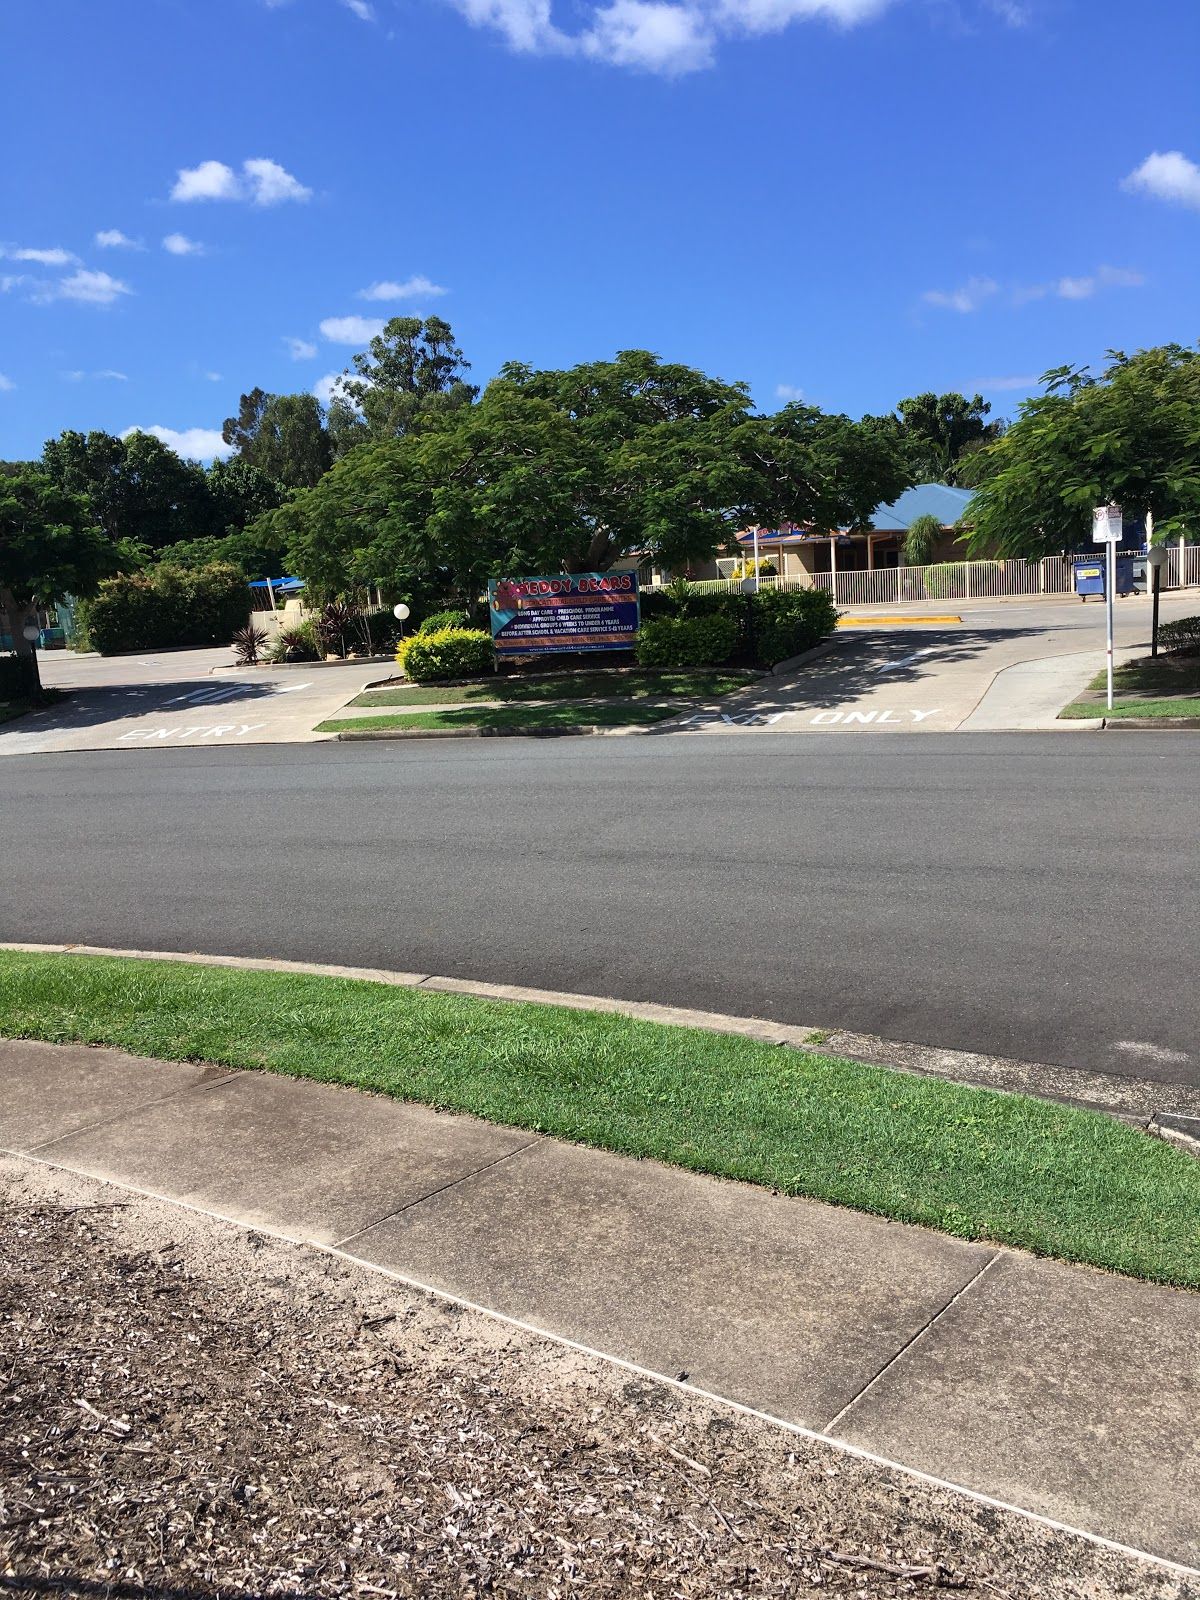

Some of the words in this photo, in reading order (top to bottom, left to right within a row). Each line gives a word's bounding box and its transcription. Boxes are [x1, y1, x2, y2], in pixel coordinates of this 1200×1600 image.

[578, 575, 631, 592] BEARS
[682, 713, 794, 726] EXIT
[809, 708, 941, 725] ONLY
[117, 723, 268, 740] ENTRY
